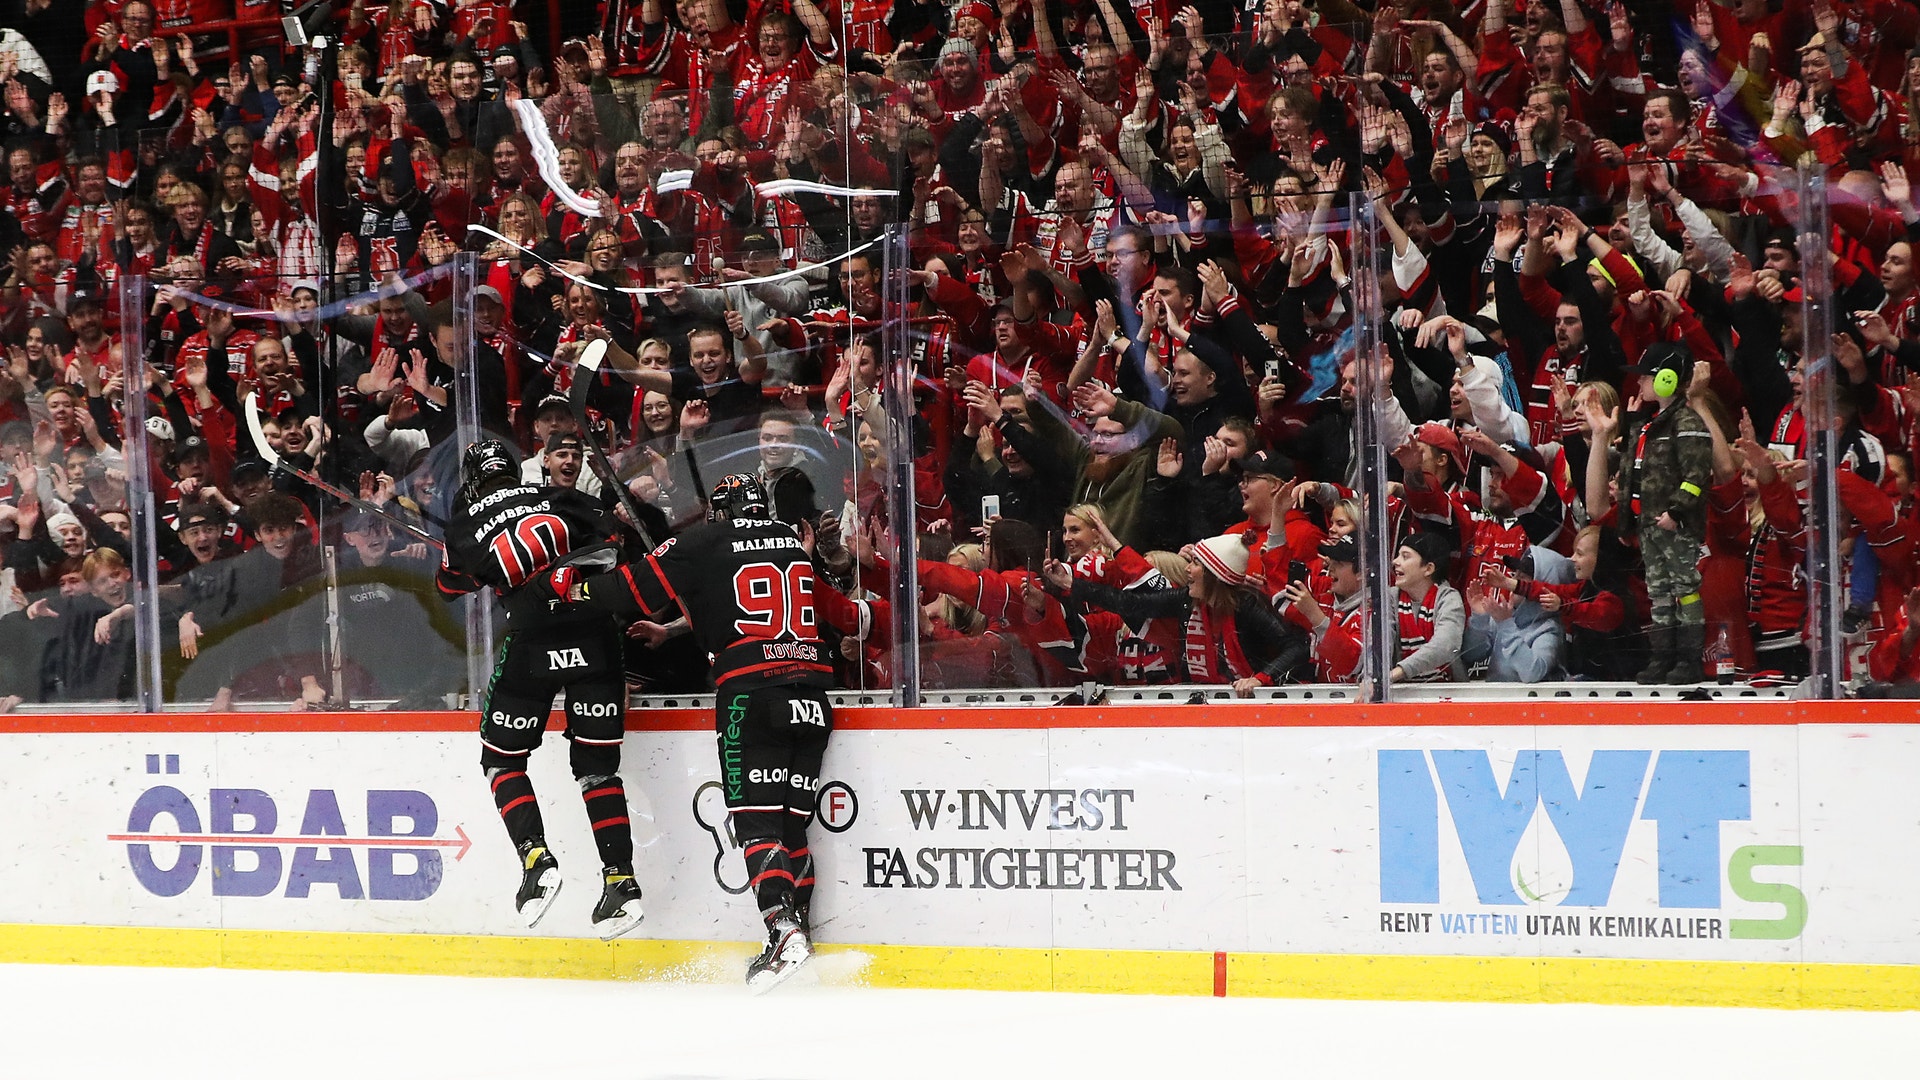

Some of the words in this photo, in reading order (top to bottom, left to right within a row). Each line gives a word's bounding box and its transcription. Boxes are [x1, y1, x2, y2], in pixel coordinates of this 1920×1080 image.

[468, 486, 539, 517] ByggTema
[489, 513, 571, 588] 10
[731, 536, 803, 553] MALMBER
[546, 647, 589, 670] NA
[762, 640, 819, 662] KOVÁCS
[788, 699, 826, 727] NA
[829, 791, 847, 823] F
[127, 754, 443, 901] ÖBAB
[862, 846, 1183, 891] FASTIGHETER
[1380, 912, 1432, 934] RENT
[1440, 913, 1518, 935] VATTEN
[1526, 914, 1581, 937] UTAN
[1590, 915, 1723, 940] KEMIKALIER
